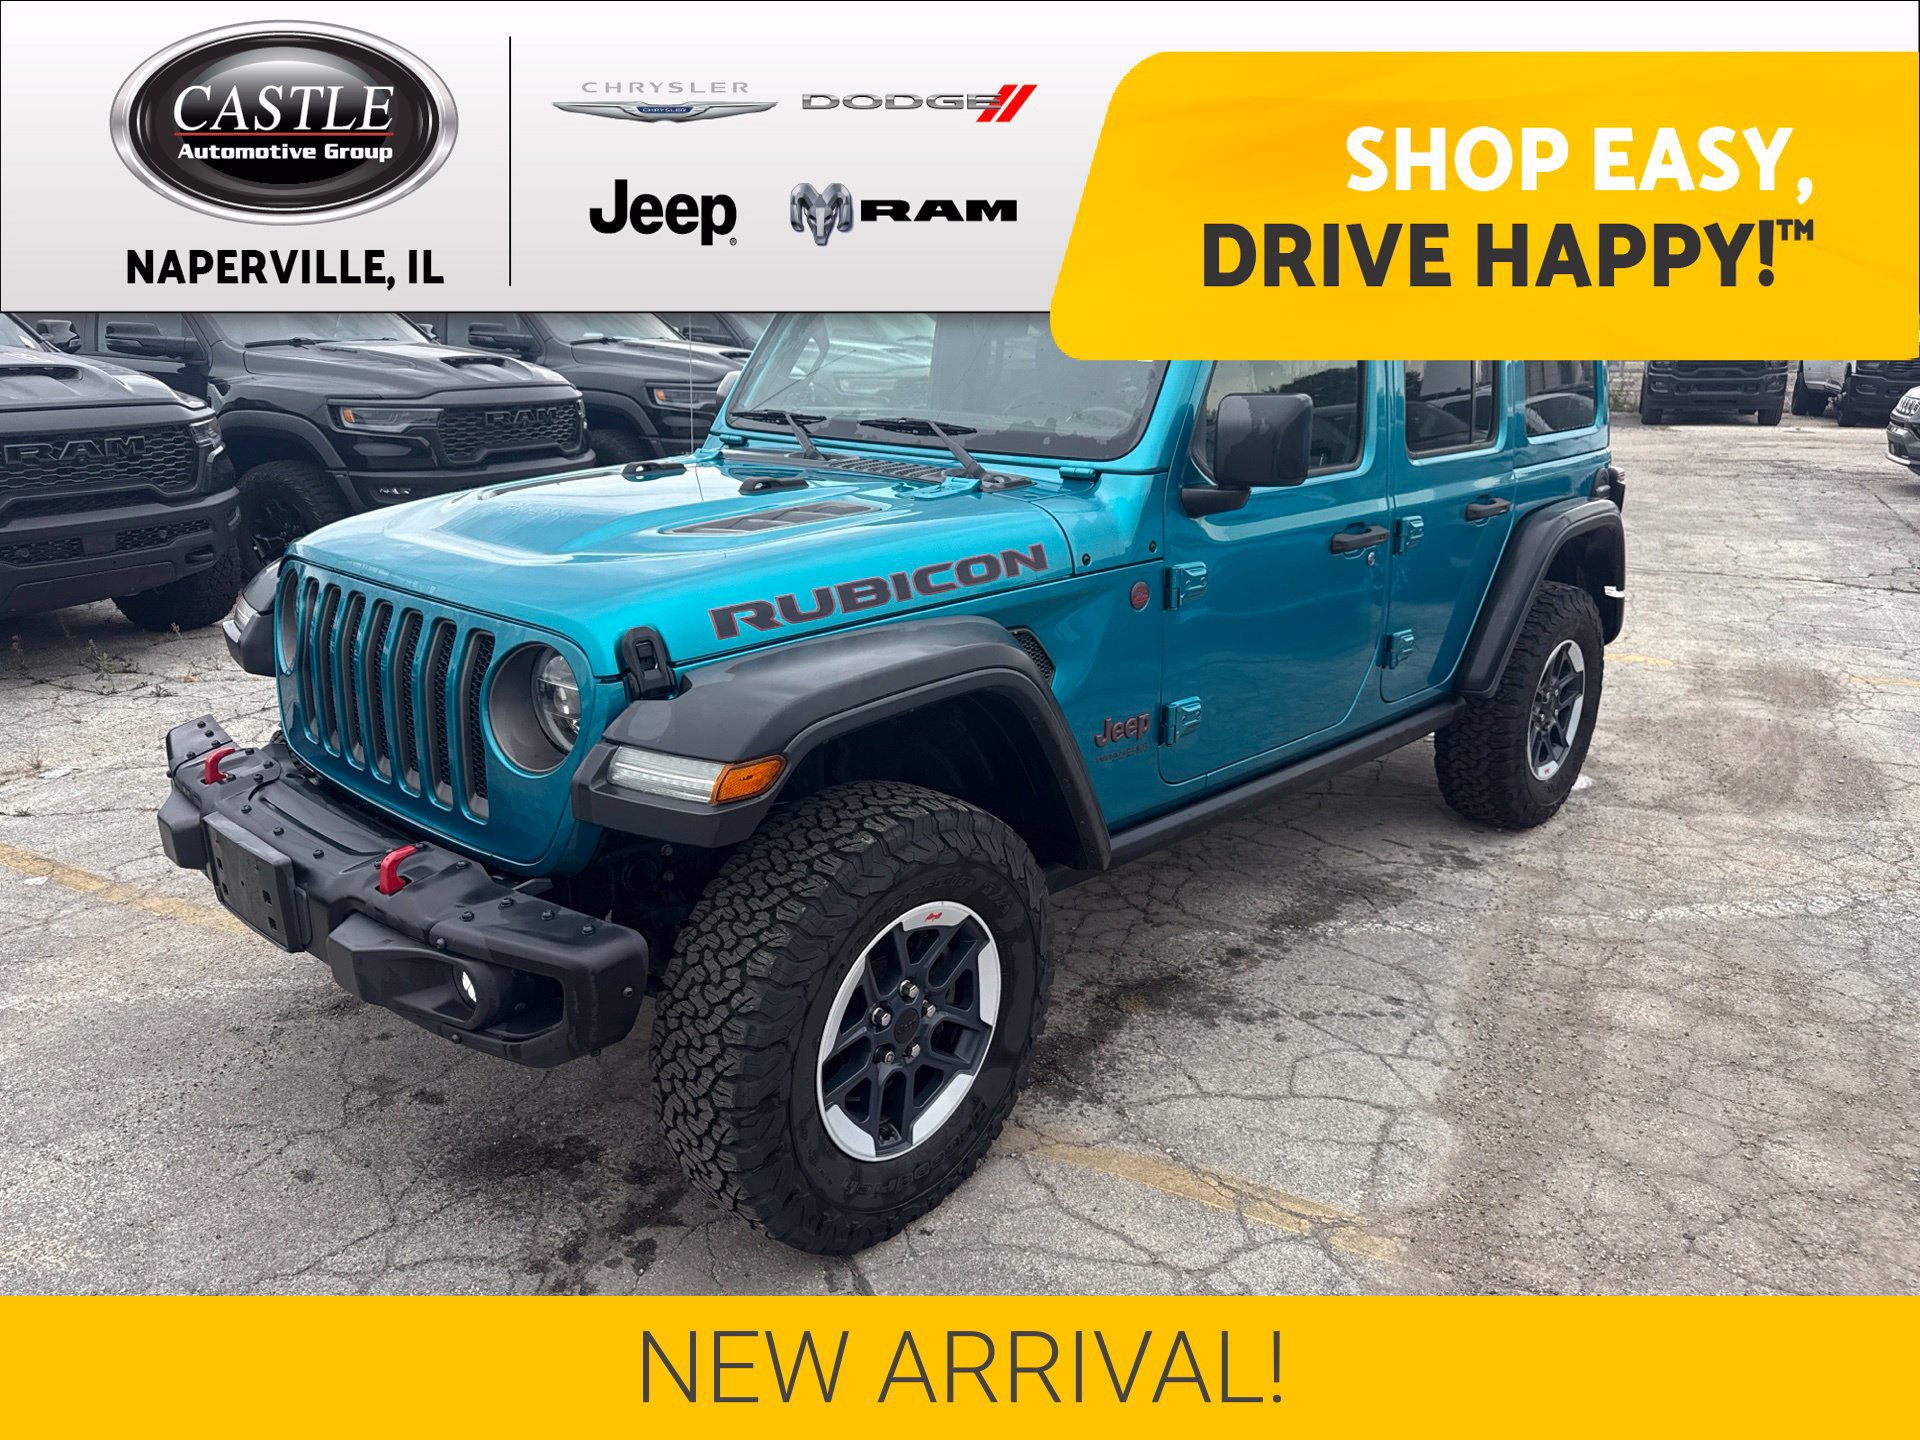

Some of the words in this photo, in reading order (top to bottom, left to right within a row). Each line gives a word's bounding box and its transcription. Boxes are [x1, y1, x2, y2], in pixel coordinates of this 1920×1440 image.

[485, 406, 558, 427] RAM
[3, 435, 147, 466] RAM
[708, 543, 1049, 640] RUBICON
[1094, 713, 1150, 748] Jeep
